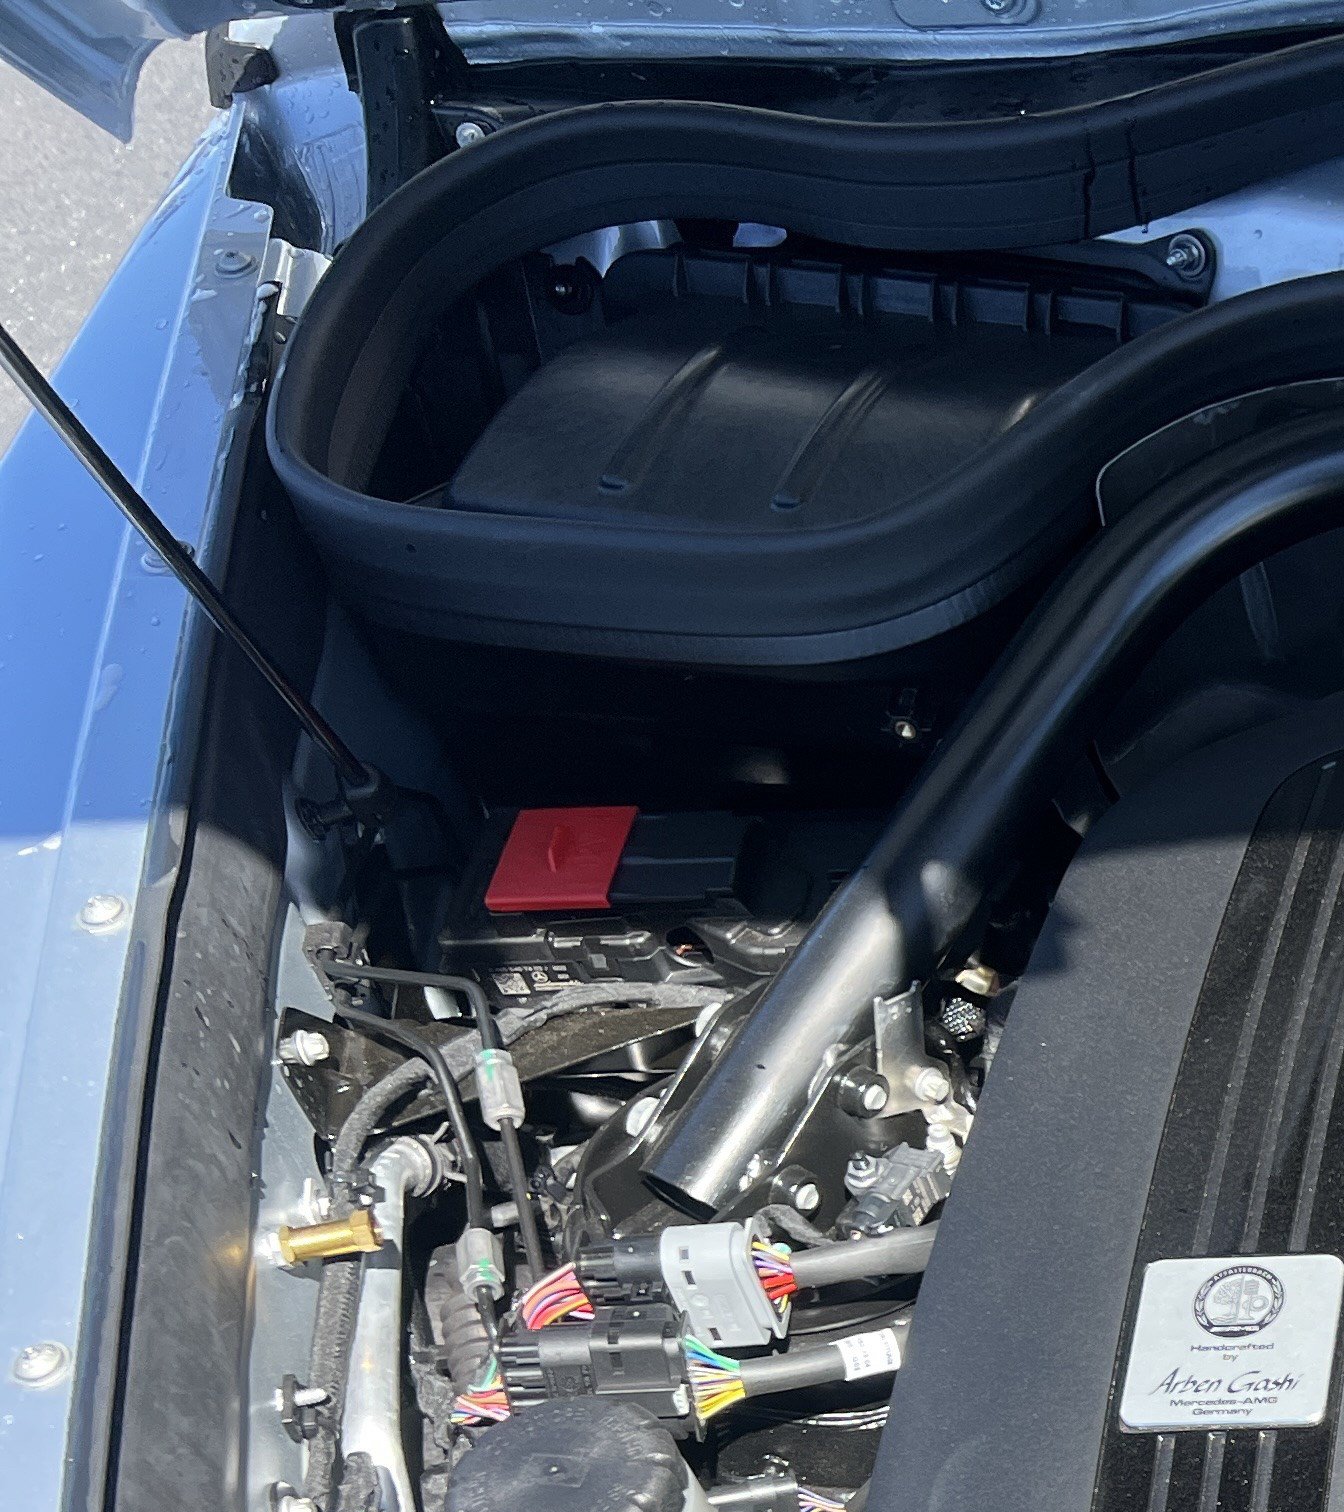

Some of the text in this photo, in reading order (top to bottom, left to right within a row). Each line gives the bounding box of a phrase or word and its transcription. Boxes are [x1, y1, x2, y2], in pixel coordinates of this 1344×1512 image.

[1190, 1342, 1275, 1352] Handcrafted
[1222, 1352, 1239, 1362] by
[1147, 1367, 1224, 1396] Arben
[1169, 1397, 1278, 1407] Mercedes-AMG
[1192, 1407, 1254, 1416] Germany
